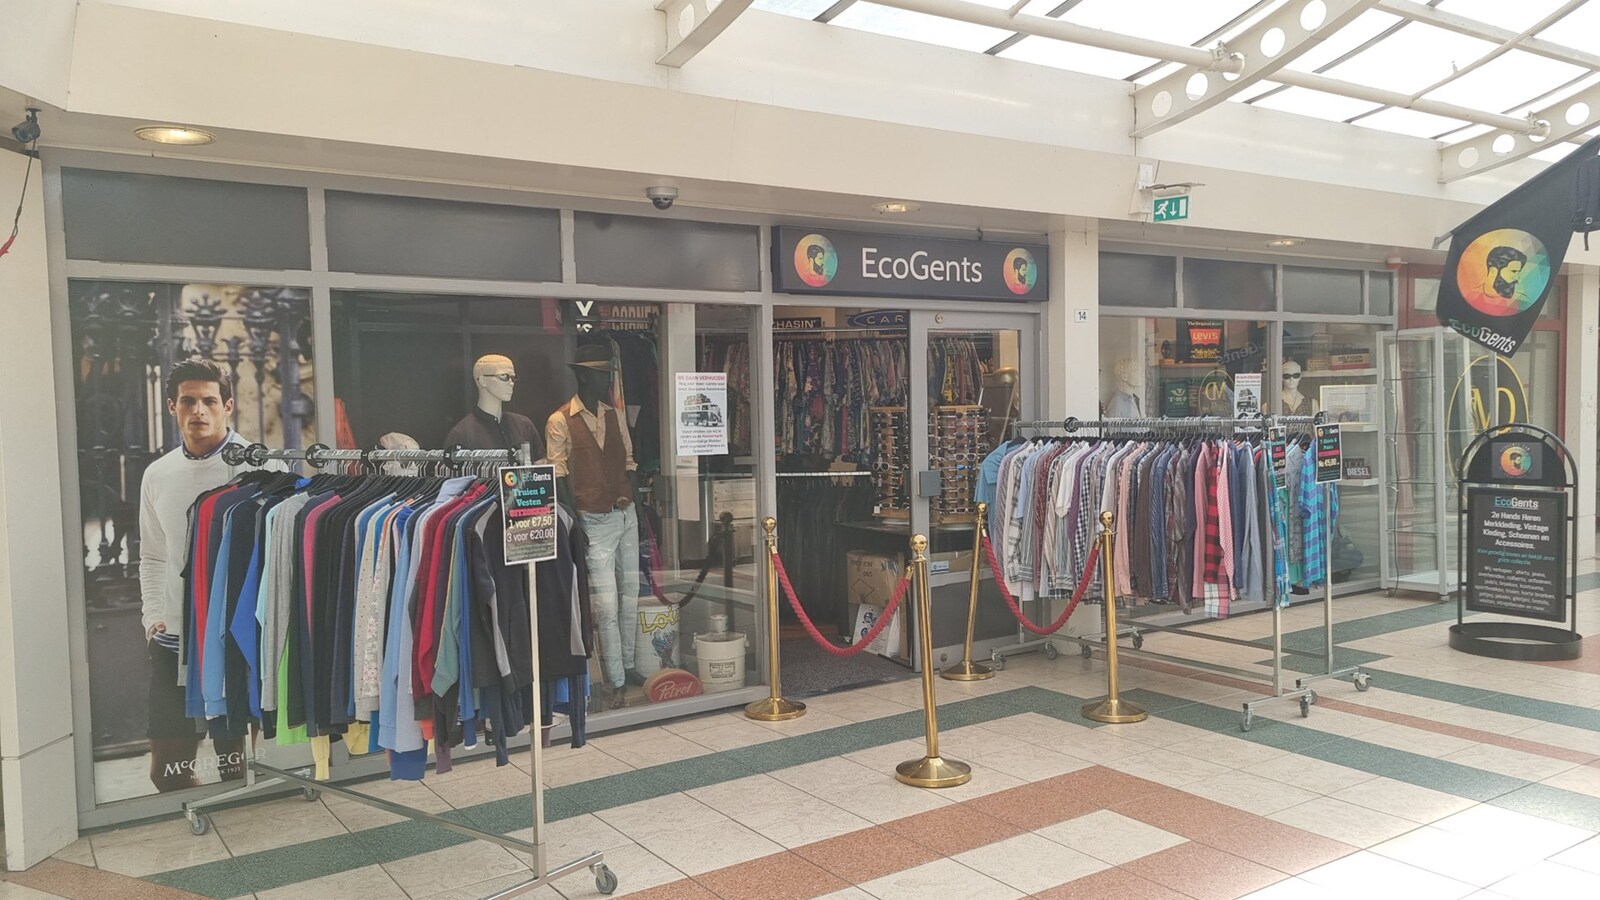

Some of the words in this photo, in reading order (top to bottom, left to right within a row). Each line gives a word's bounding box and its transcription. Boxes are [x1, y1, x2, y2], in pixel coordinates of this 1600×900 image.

[862, 247, 983, 283] EcoGents
[1078, 312, 1086, 320] 14
[1449, 318, 1516, 353] EcoGents
[1347, 468, 1370, 476] DIESEL
[512, 488, 538, 496] Truien
[516, 498, 542, 507] Vesten
[1494, 496, 1539, 510] EcoGents
[515, 520, 530, 529] voor
[532, 516, 552, 527] €7,50
[1523, 523, 1549, 533] Vintage
[507, 534, 512, 542] 3
[514, 533, 528, 542] voor
[530, 528, 554, 540] €20,00
[1508, 531, 1540, 540] Schoenen
